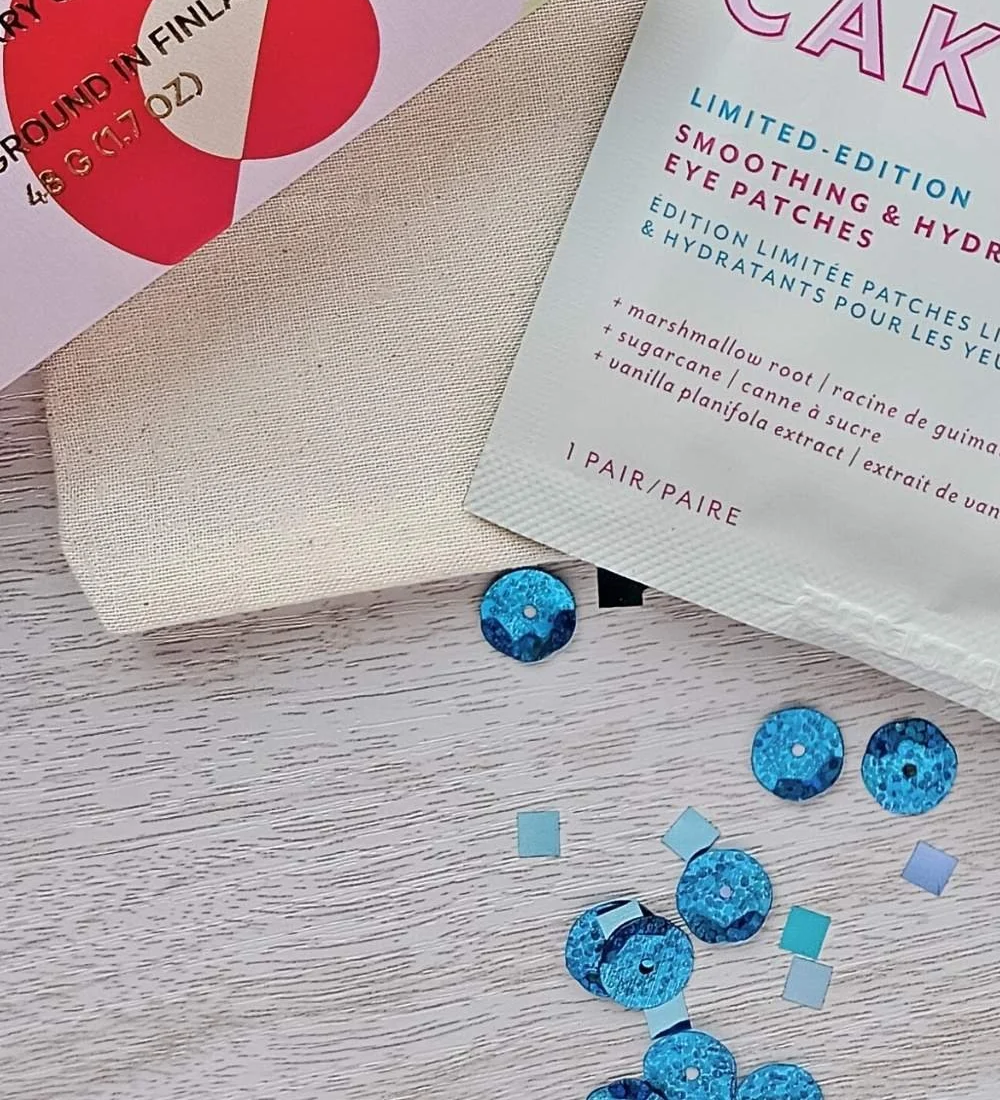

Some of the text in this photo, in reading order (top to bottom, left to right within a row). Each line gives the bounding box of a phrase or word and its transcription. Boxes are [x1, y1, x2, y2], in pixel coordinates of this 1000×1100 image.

[109, 44, 152, 84] IN
[26, 70, 204, 206] 48 G (1.7 OZ)
[675, 124, 869, 213] SMOOTHING
[882, 205, 900, 226] &
[690, 87, 971, 209] LIMITED-EDITION
[664, 153, 873, 248] EYE PATCHES
[641, 220, 654, 237] &
[664, 229, 826, 303] HYDRATANTS
[834, 296, 901, 334] POUR
[911, 324, 953, 350] LES
[650, 194, 748, 248] ÉDITION
[757, 239, 854, 288] LIMITÉE
[862, 280, 971, 331] PATCHES
[618, 332, 721, 381] sugarcane
[741, 382, 801, 412] canne
[808, 404, 820, 420] à
[825, 415, 881, 443] sucre
[628, 305, 762, 366] marshmallow
[769, 361, 813, 386] root
[832, 385, 898, 418] racine
[904, 408, 927, 429] de
[567, 442, 742, 526] 1 PAIR/PAIRE
[609, 358, 675, 393] vanilla
[677, 387, 768, 430] planifola
[774, 426, 844, 460] extract
[864, 460, 931, 493] extrait
[936, 483, 958, 503] de
